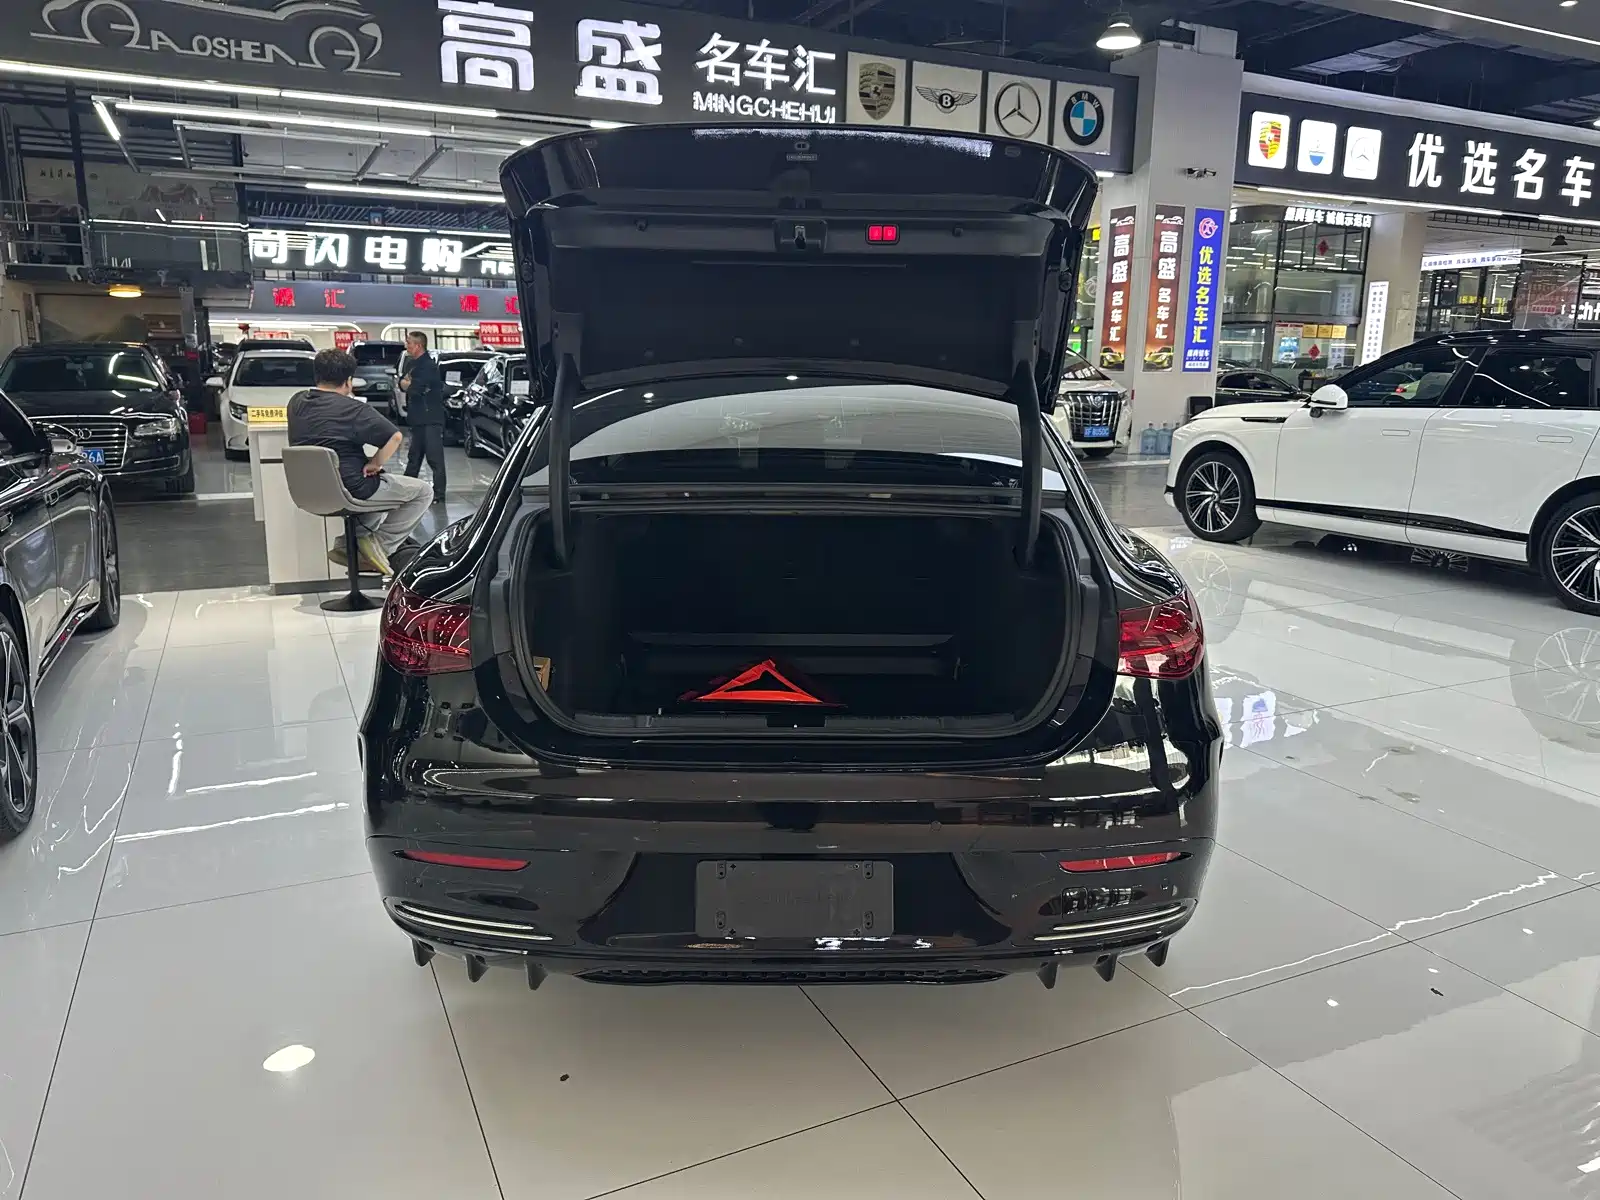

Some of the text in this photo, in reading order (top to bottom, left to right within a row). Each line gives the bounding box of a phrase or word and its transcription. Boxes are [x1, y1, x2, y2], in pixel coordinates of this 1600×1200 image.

[694, 32, 836, 96] 名车汇
[692, 90, 836, 124] MINGCHEHUI
[1070, 92, 1100, 109] BMW
[1407, 131, 1597, 208] 优选名车
[1192, 245, 1214, 344] 优选名车汇
